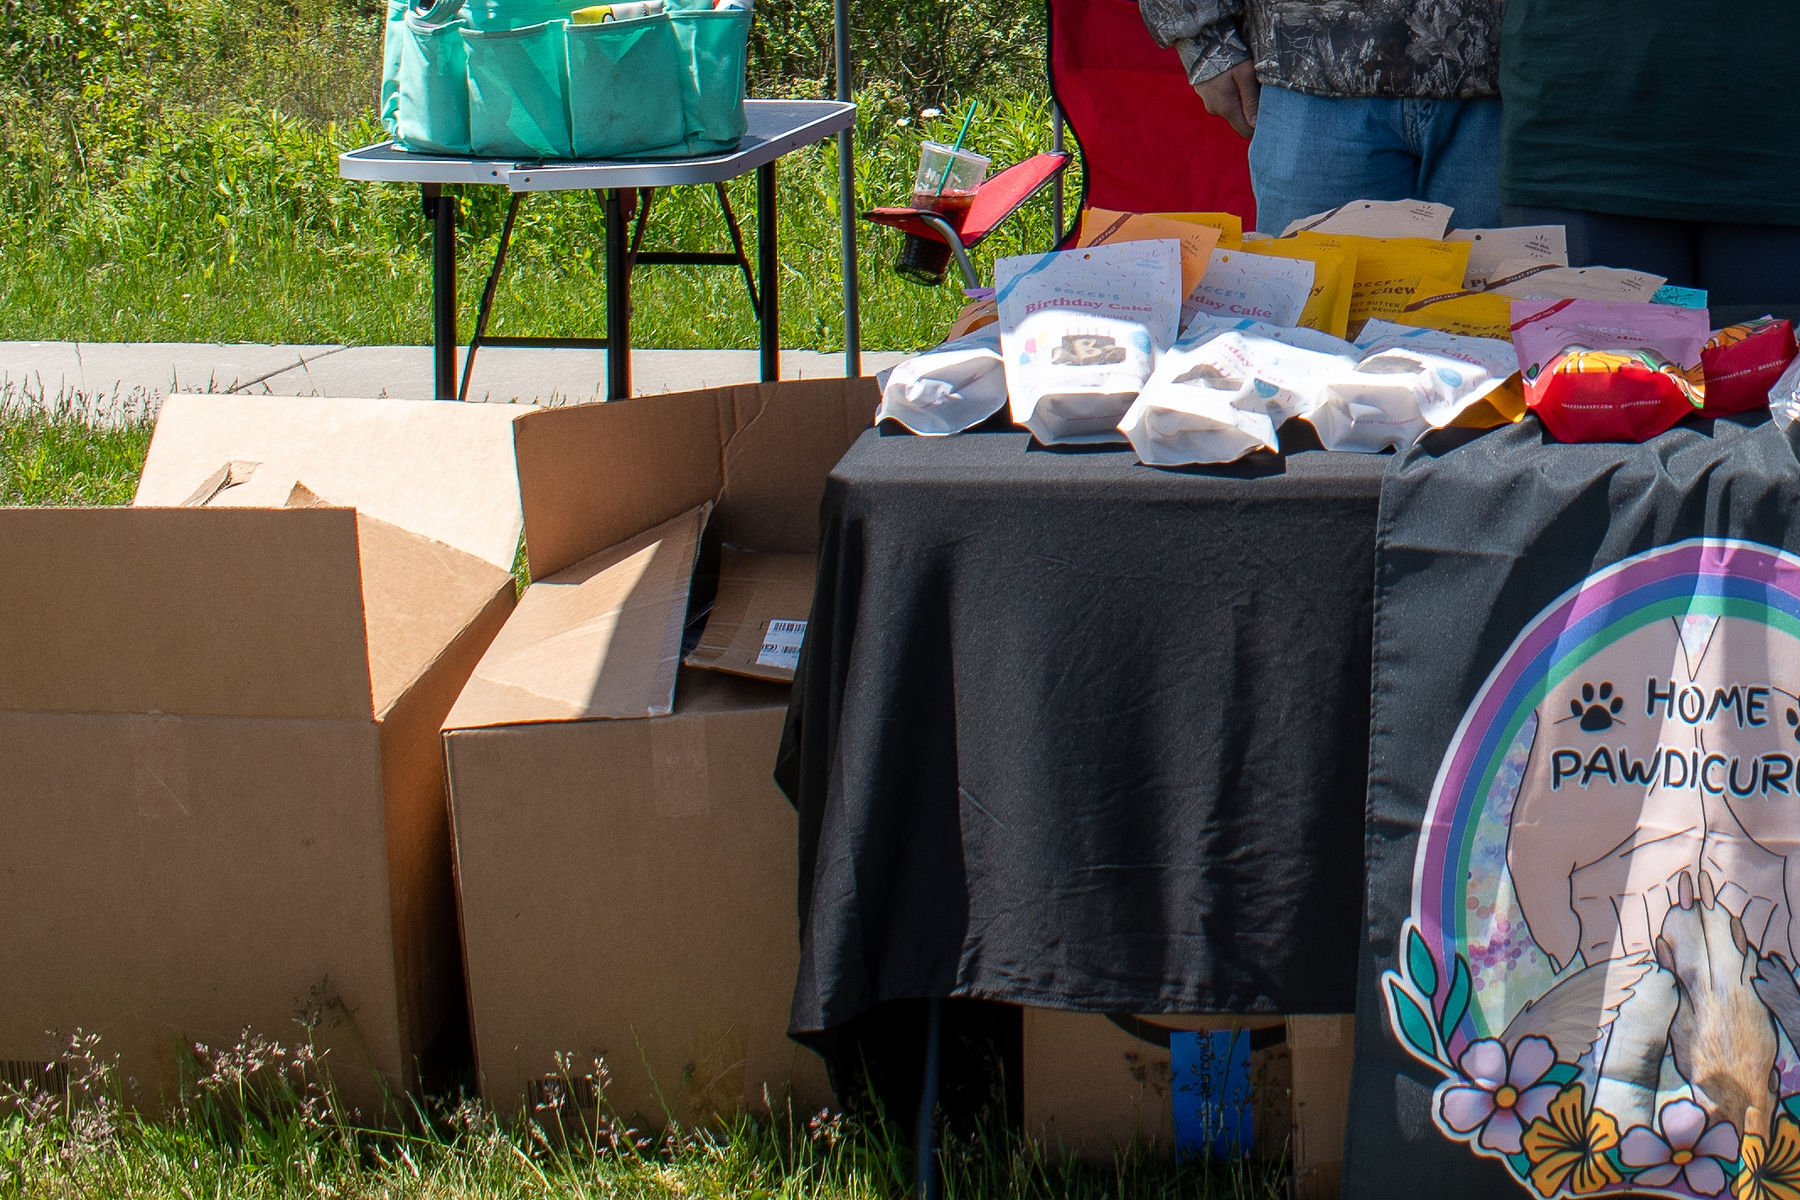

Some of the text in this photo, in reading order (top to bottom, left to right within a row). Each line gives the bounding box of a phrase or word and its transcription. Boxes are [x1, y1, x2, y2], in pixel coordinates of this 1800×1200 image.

[1025, 297, 1104, 315] Birthday
[1108, 303, 1153, 313] Cake
[1229, 303, 1273, 318] Cake
[1647, 677, 1770, 729] HOME
